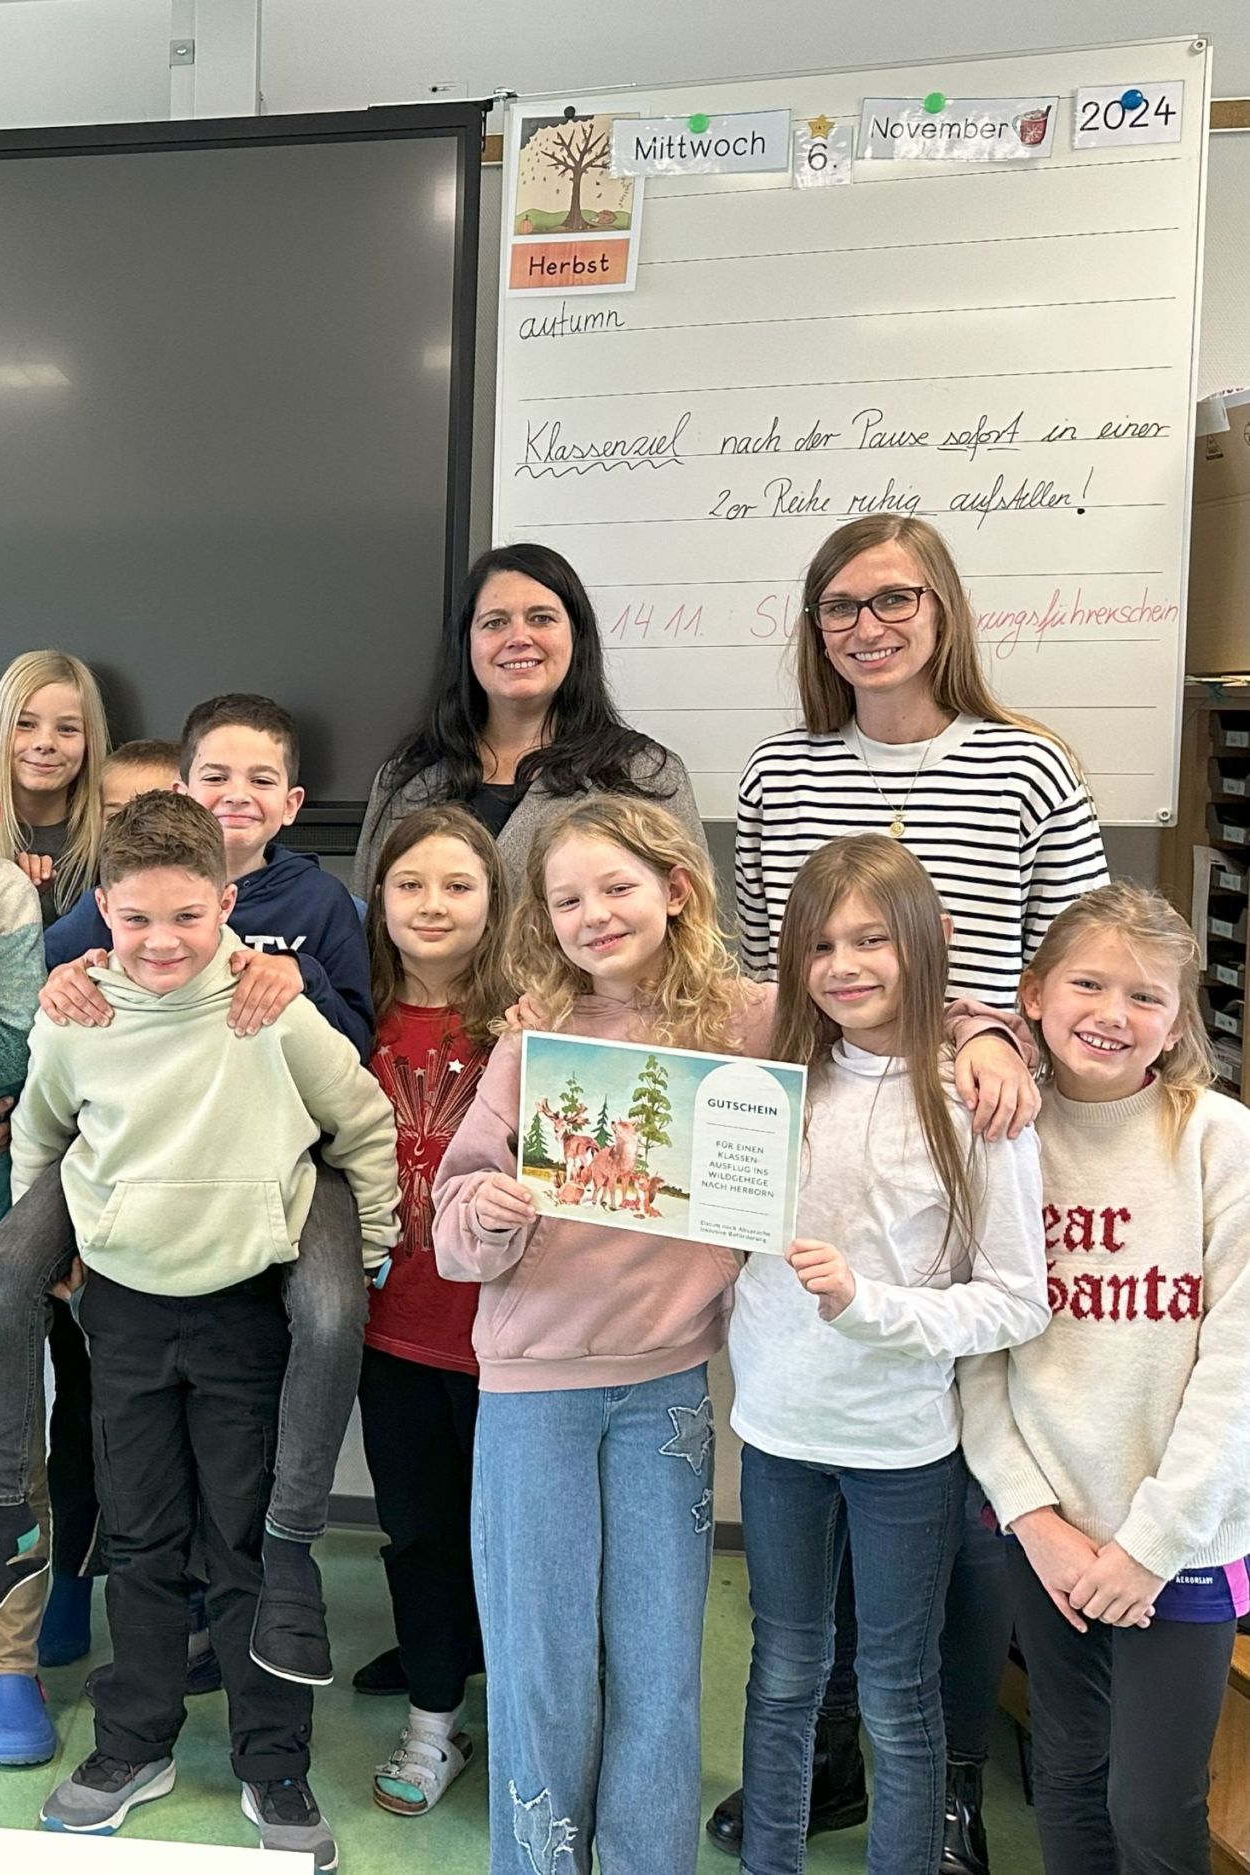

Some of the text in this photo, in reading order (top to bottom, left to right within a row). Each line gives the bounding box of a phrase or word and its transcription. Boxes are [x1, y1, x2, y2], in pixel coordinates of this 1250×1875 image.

[1079, 96, 1176, 132] 2024
[870, 117, 1009, 139] November
[635, 131, 766, 161] Mittwoch
[807, 143, 838, 171] 6.
[528, 254, 610, 276] Herbst
[519, 301, 626, 340] autumn
[720, 416, 781, 455] nach
[794, 419, 841, 451] der
[852, 408, 930, 450] Pause
[942, 410, 1024, 462] sofort
[1041, 418, 1078, 442] in
[764, 477, 831, 517] Reihe
[846, 477, 922, 515] ruhig
[707, 1098, 778, 1117] GUTSCHEIN
[716, 1140, 764, 1154] FÜR EINEN
[709, 1161, 769, 1176] AUSFLUG INS
[701, 1180, 774, 1198] NACH HERBORN
